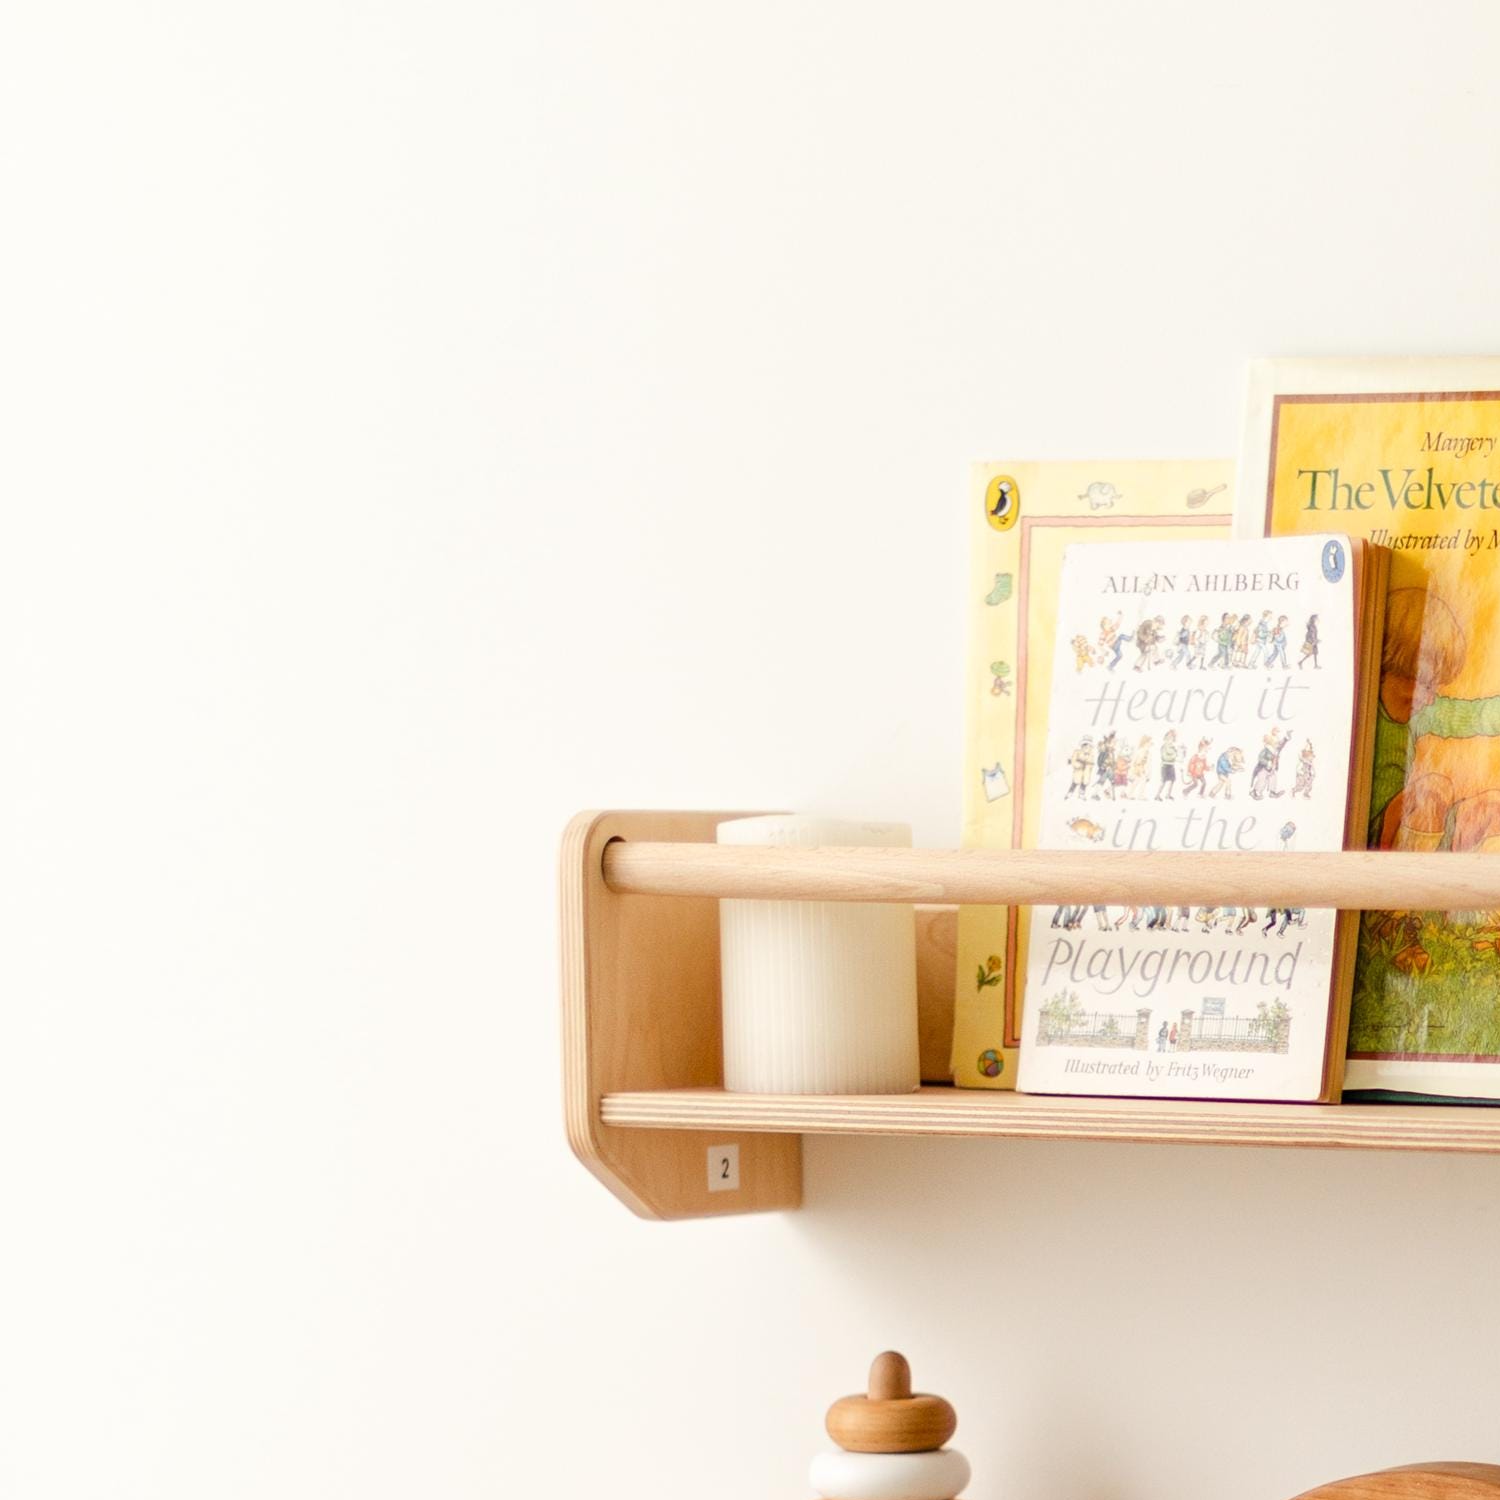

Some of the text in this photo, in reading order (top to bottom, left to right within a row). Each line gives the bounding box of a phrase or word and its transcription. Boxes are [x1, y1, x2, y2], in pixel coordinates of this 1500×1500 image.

[1420, 431, 1497, 458] Margery
[1297, 468, 1375, 511] The
[1369, 529, 1461, 550] Illustrated
[1463, 529, 1485, 556] by
[1186, 571, 1301, 593] AHLBERG
[1084, 675, 1311, 727] Heard it
[1111, 806, 1259, 851] in the
[1040, 937, 1305, 998] Playground
[1063, 1058, 1255, 1083] Illustrated by Fritz Wegner
[721, 1157, 730, 1179] 2
